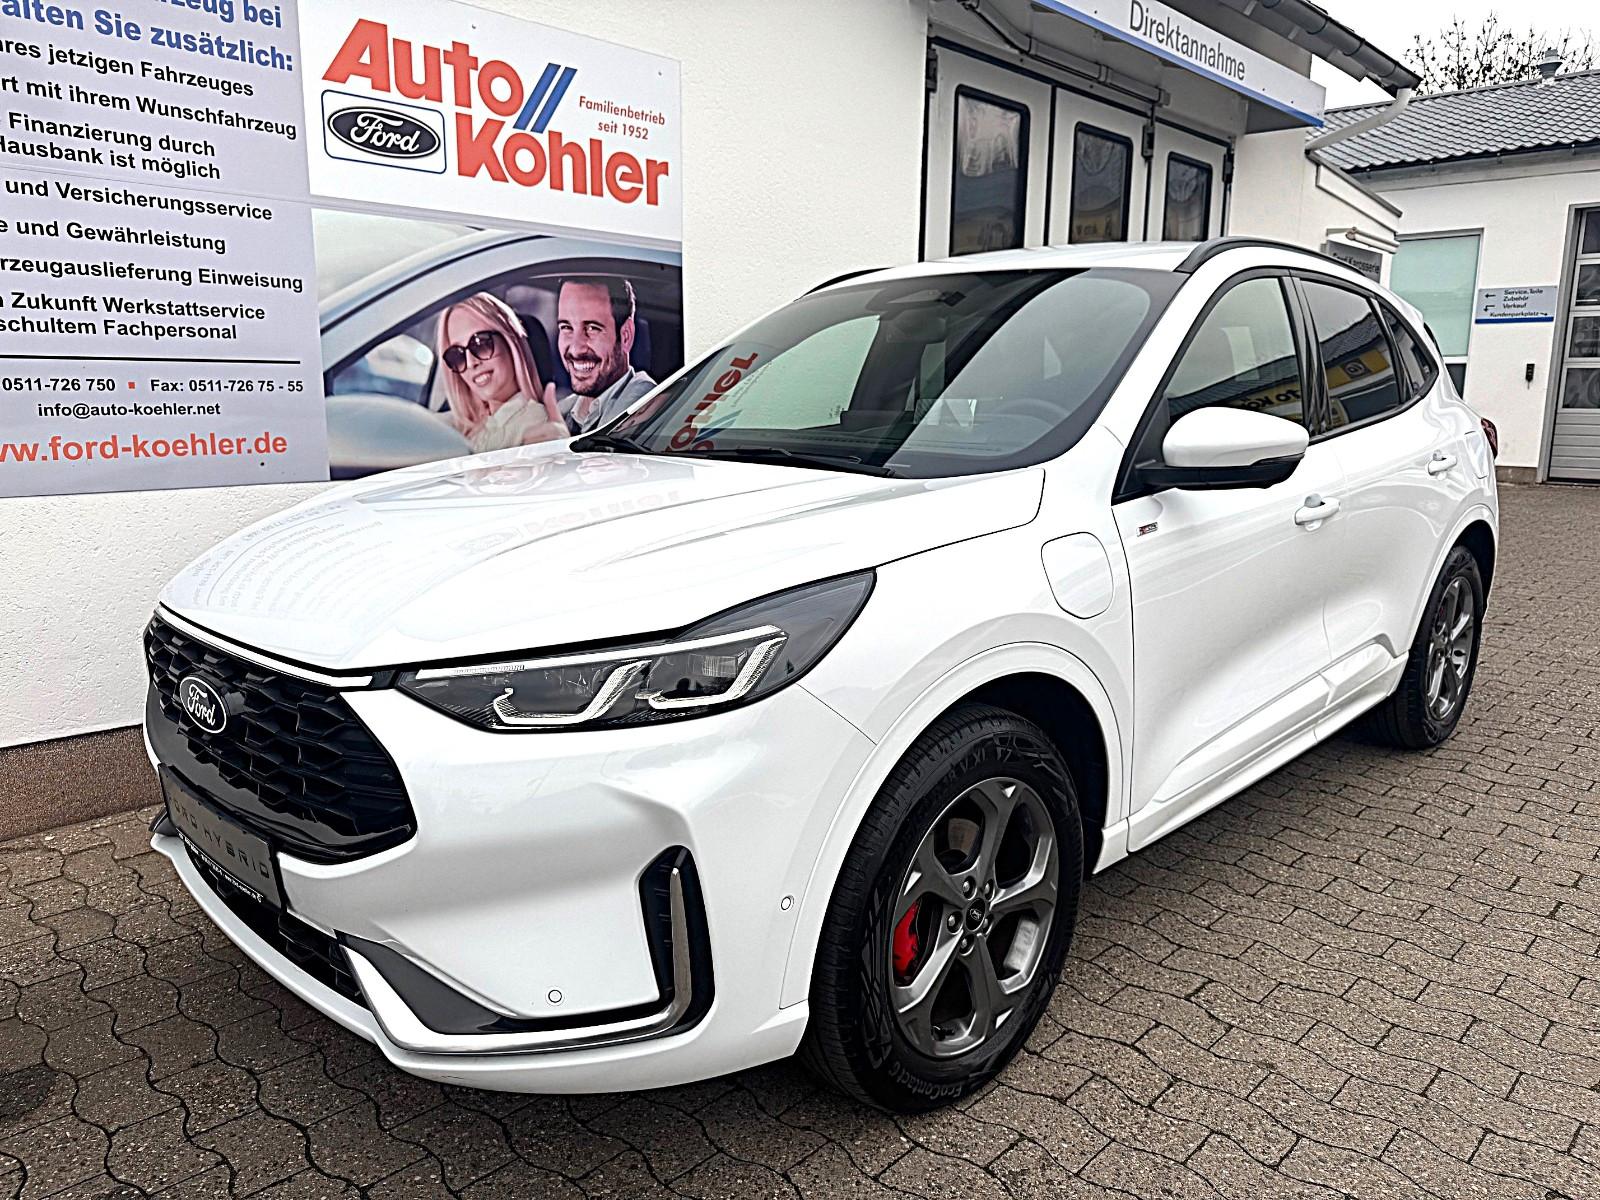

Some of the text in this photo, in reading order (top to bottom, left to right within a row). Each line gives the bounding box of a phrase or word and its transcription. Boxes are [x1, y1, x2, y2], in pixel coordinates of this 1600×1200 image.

[243, 0, 282, 28] bei
[94, 9, 142, 41] Sie
[150, 27, 293, 71] zusätzlich:
[1129, 0, 1246, 81] Direktannahme
[48, 43, 134, 75] jetzigen
[141, 61, 254, 97] Fahrzeuges
[321, 18, 524, 117] Auto
[26, 81, 63, 100] mit
[69, 84, 130, 111] ihrem
[136, 96, 297, 140] Wunschfahrzeug
[578, 95, 666, 126] Familienbetrieb
[8, 111, 216, 157] Finanzierung durch
[350, 112, 422, 153] Ford
[598, 121, 649, 140] seit 1952
[109, 151, 136, 169] ist
[141, 156, 221, 180] möglich
[5, 180, 273, 221] und Versicherungsservice
[16, 220, 60, 238] und
[66, 222, 226, 255] Gewährleistung
[0, 257, 304, 293] rzeugauslieferung Einweisung
[11, 292, 98, 312] Zukunft
[103, 296, 266, 320] Werkstattservice
[103, 319, 237, 340] Fachpersonal
[2, 378, 81, 392] 0511-726
[85, 378, 116, 392] 750
[150, 379, 184, 392] Fax:
[189, 379, 254, 393] 0511-726
[258, 380, 275, 393] 75
[287, 380, 304, 393] 55
[37, 403, 221, 420] info@auto-koehler.net
[187, 683, 216, 727] Ford
[203, 824, 270, 879] HYBRID
